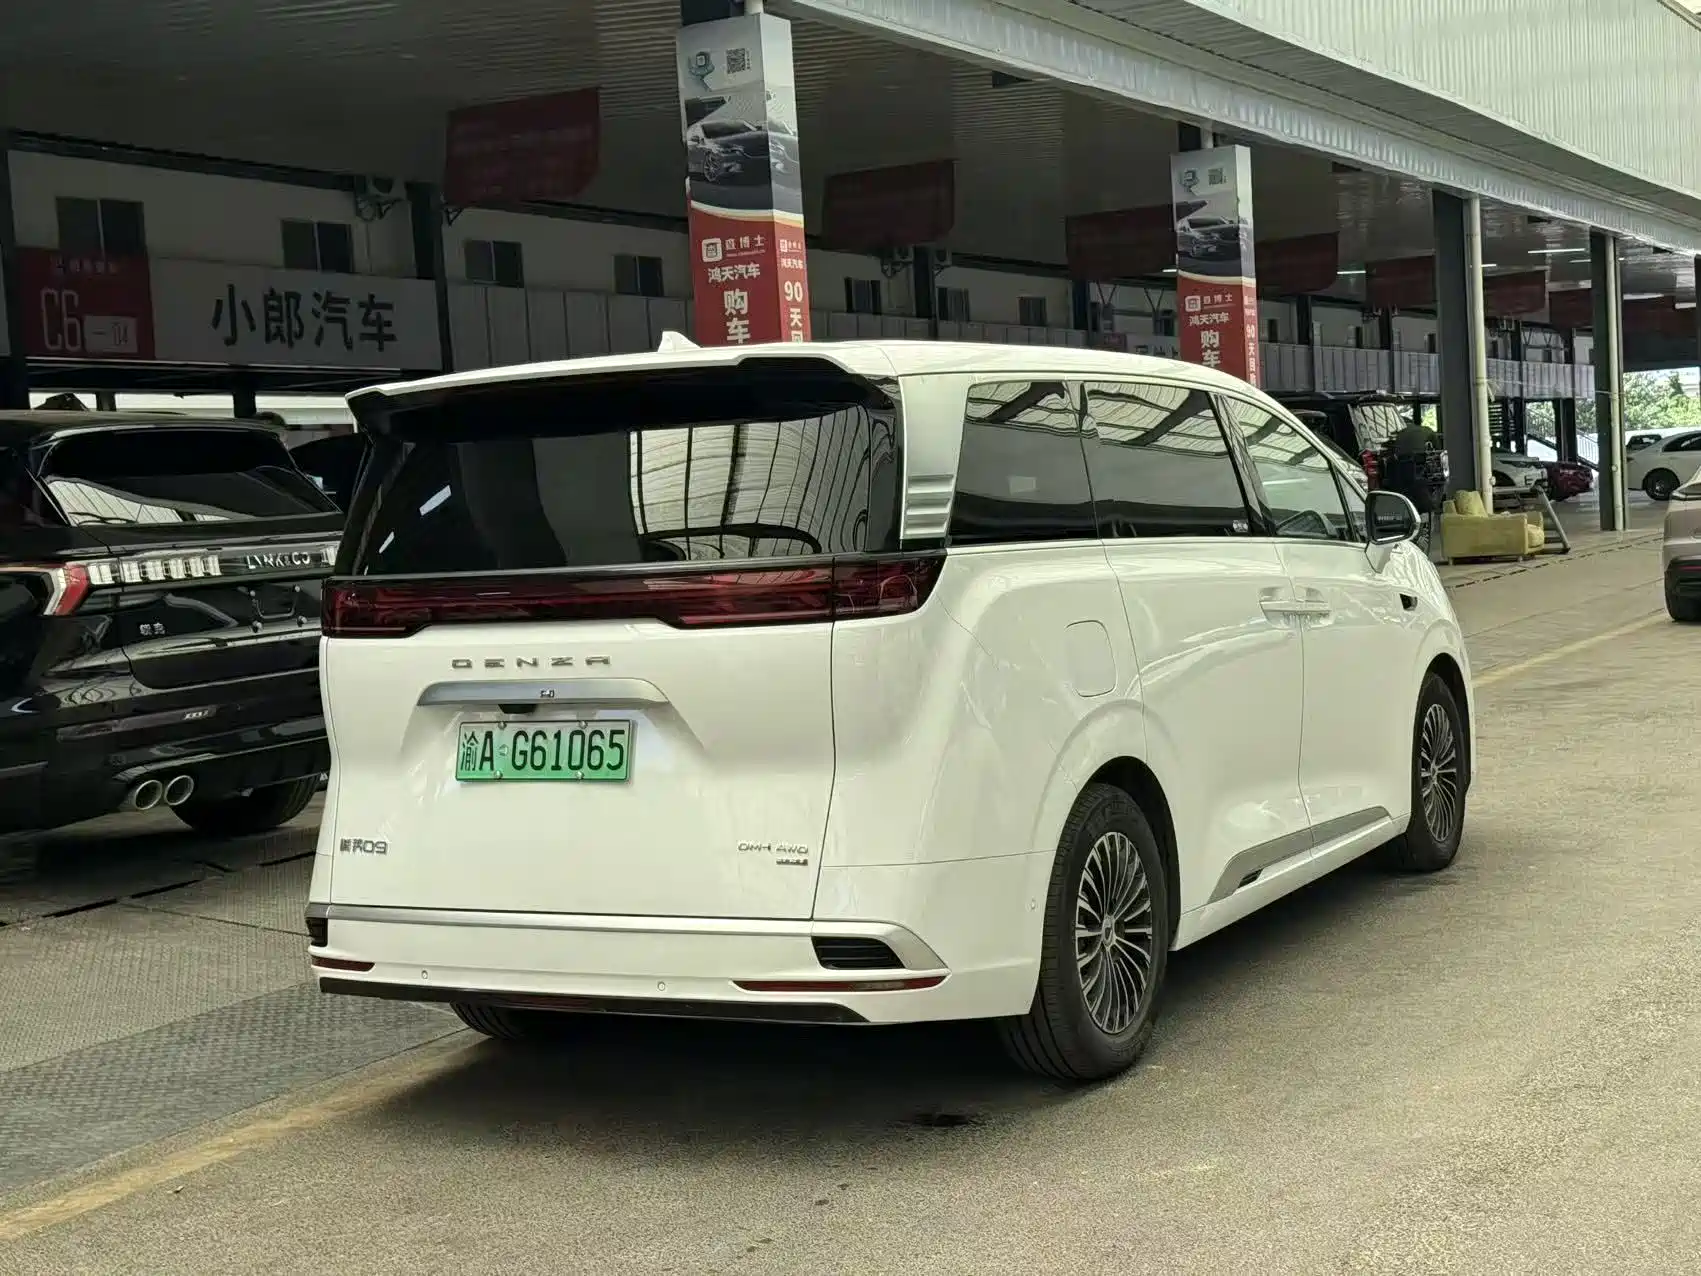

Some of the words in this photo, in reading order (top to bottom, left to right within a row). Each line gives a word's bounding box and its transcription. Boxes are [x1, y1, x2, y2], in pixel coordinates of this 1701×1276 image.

[708, 262, 761, 284] 鸿天汽车
[211, 283, 398, 352] 小郎汽车
[723, 288, 752, 344] 购车
[1188, 312, 1230, 327] 鸿天汽车
[1200, 329, 1221, 368] 购车
[451, 655, 611, 669] DENZA
[511, 729, 625, 771] G61065
